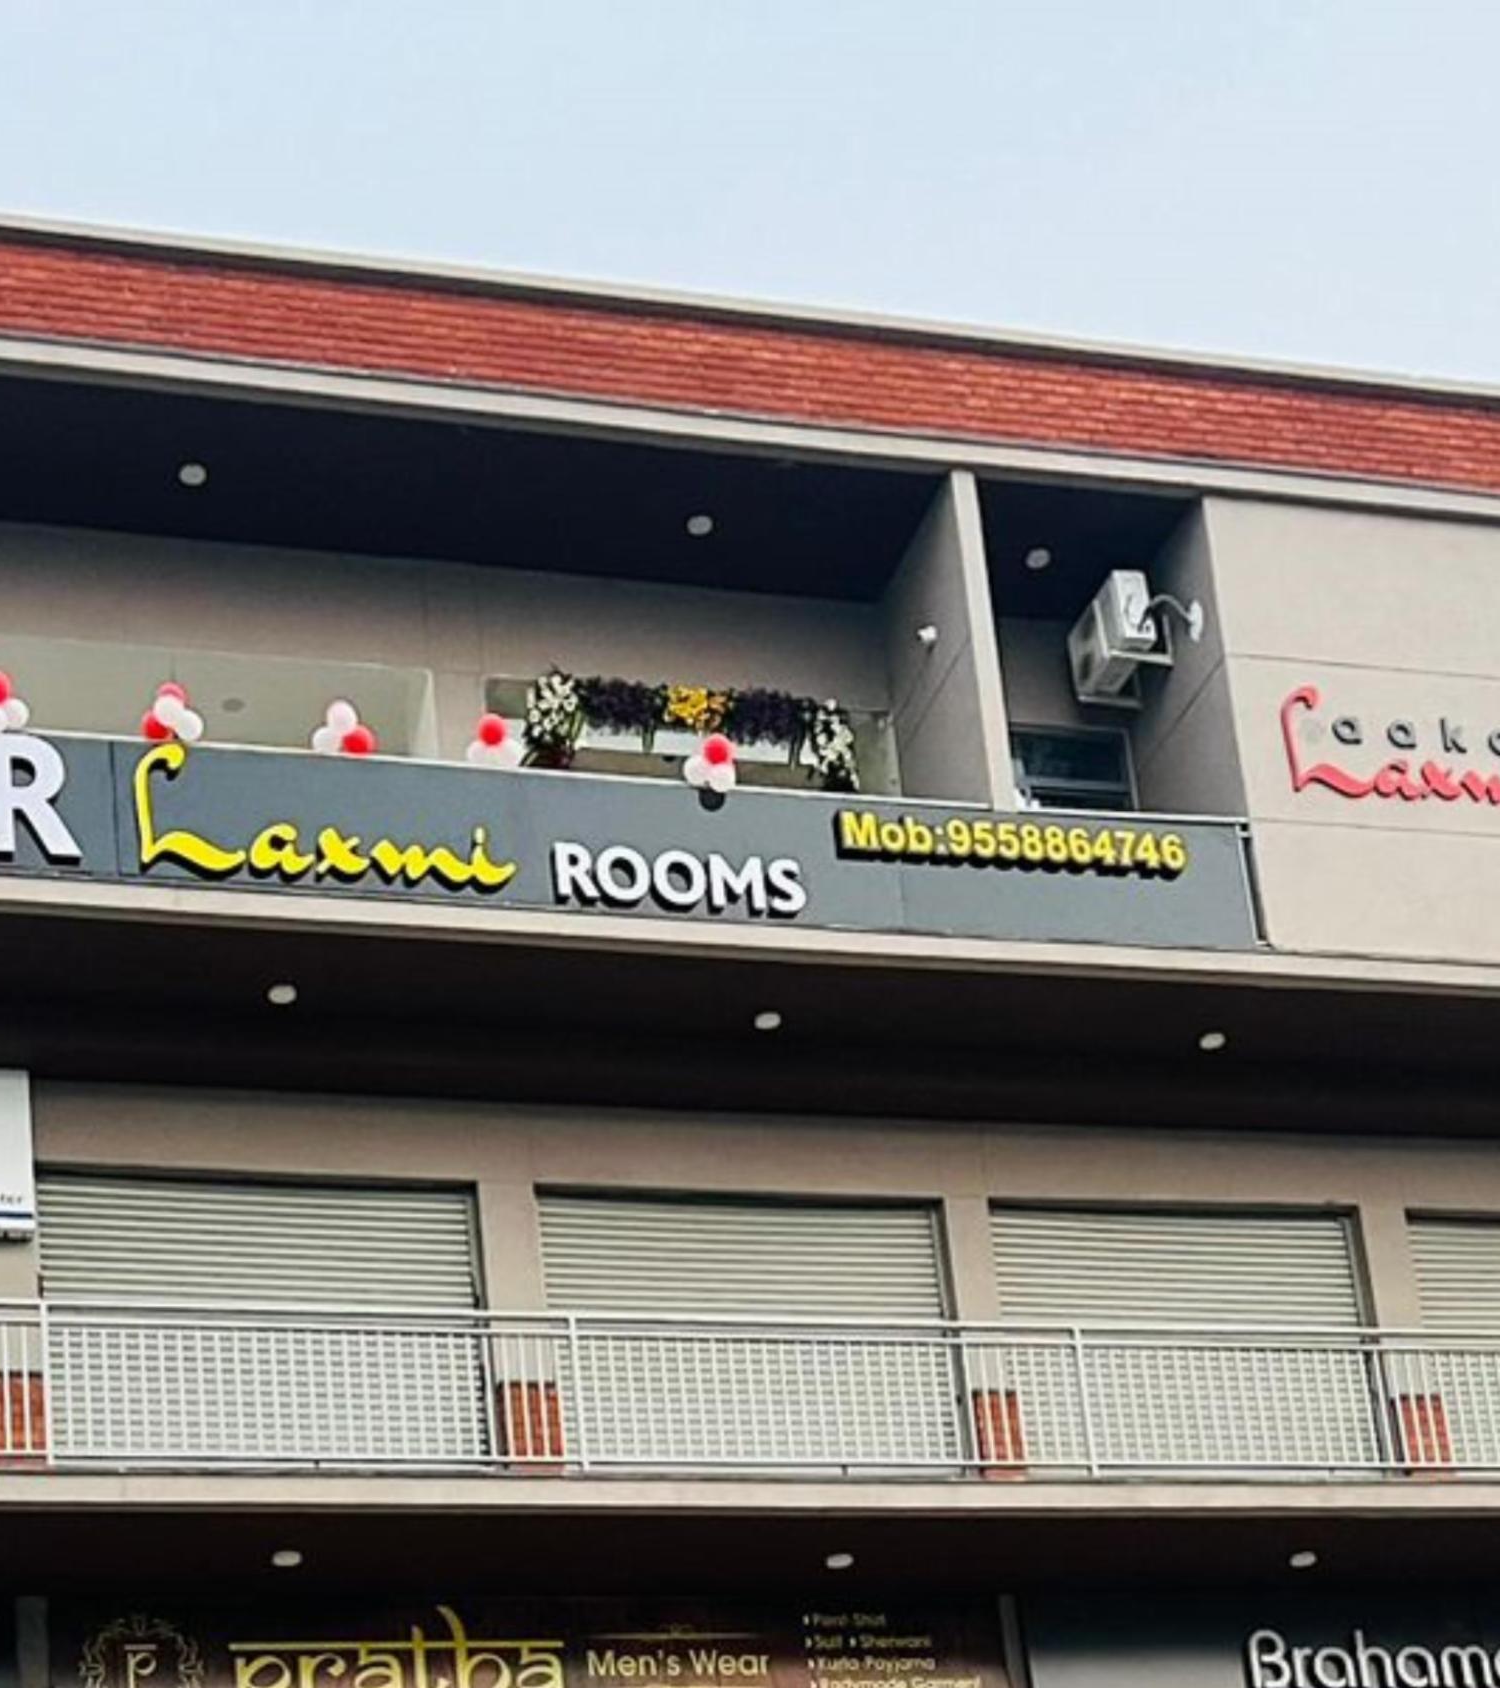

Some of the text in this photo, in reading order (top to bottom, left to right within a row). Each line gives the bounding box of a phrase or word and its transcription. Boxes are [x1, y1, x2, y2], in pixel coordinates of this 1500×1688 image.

[134, 743, 517, 890] Laxmi
[553, 843, 808, 917] ROOMS
[837, 808, 1186, 876] Mob:9558864746
[586, 1649, 769, 1677] Men's Wear
